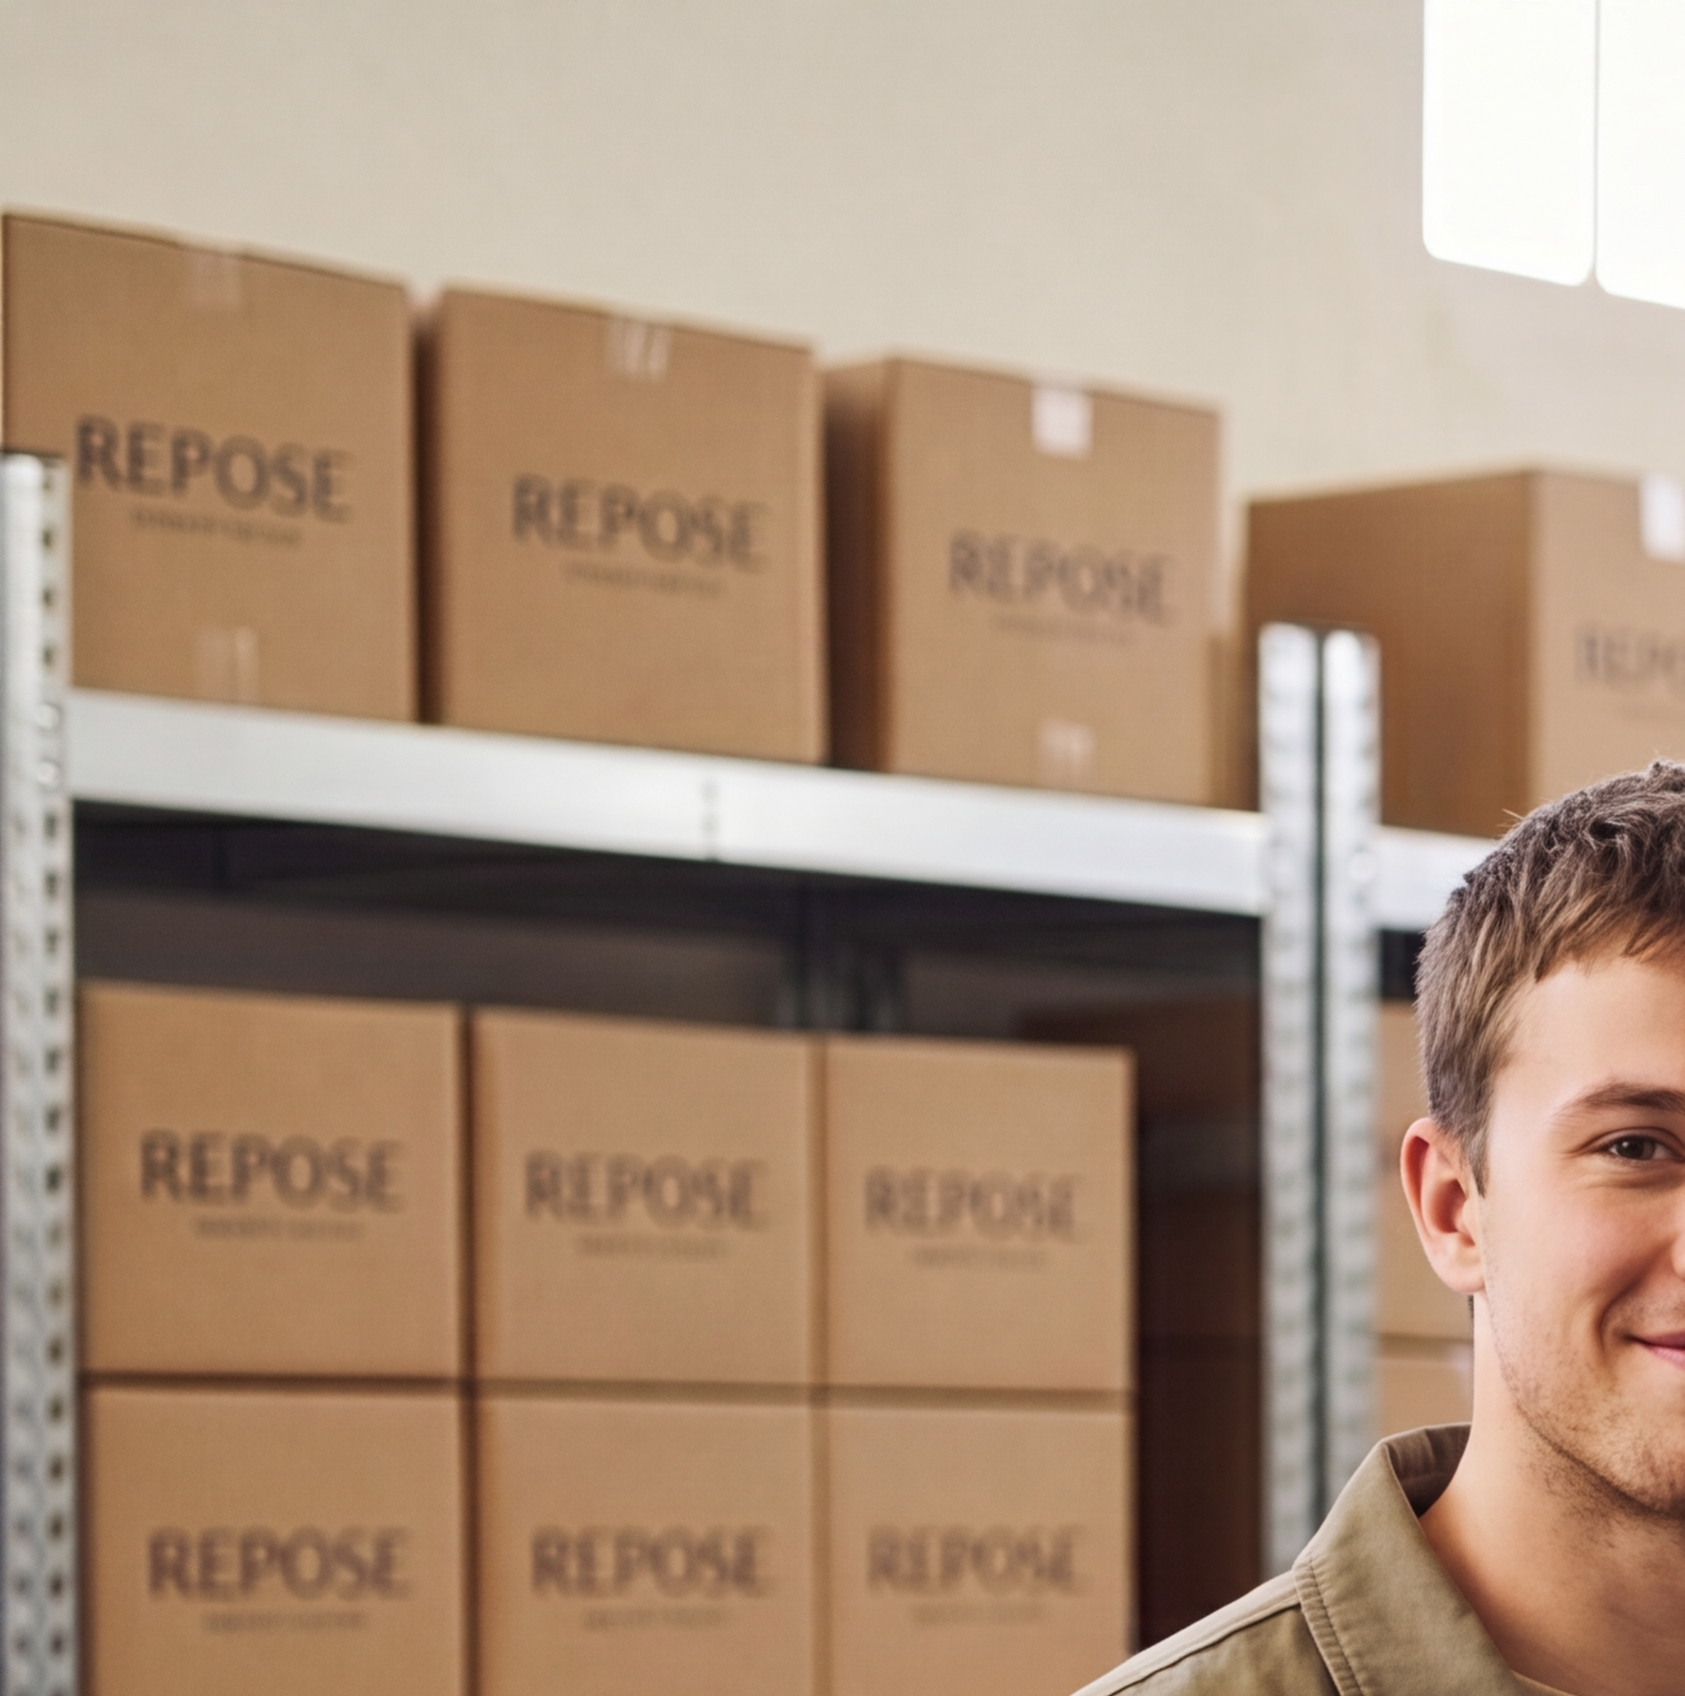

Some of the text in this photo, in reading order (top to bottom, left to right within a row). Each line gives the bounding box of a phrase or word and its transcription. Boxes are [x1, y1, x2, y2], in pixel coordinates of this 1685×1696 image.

[75, 414, 353, 525] REPOSE
[511, 473, 774, 575] REPOSE
[949, 526, 1176, 626] REPOSE
[139, 1125, 407, 1214] REPOSE
[523, 1149, 773, 1231] REPOSE
[860, 1163, 1090, 1244] REPOSE
[147, 1525, 412, 1602] REPOSE
[530, 1522, 774, 1599] REPOSE
[864, 1522, 1089, 1599] REPOSE
